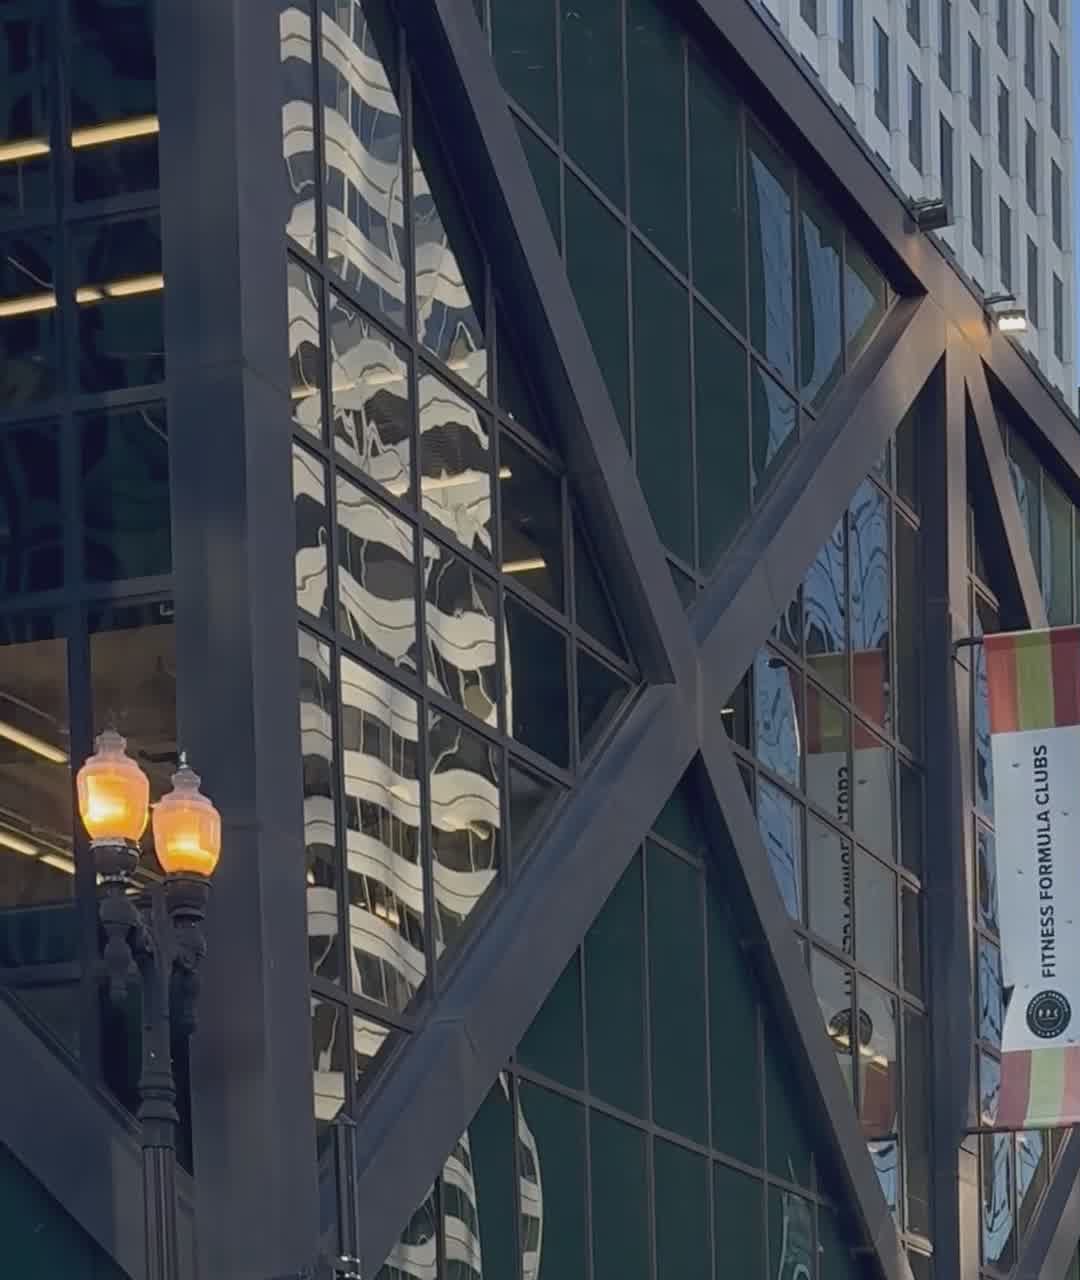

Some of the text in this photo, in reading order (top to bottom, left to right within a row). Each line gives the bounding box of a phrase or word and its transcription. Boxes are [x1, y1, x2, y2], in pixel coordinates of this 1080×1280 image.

[1033, 744, 1056, 978] FITNESS FORMULA CLUBS
